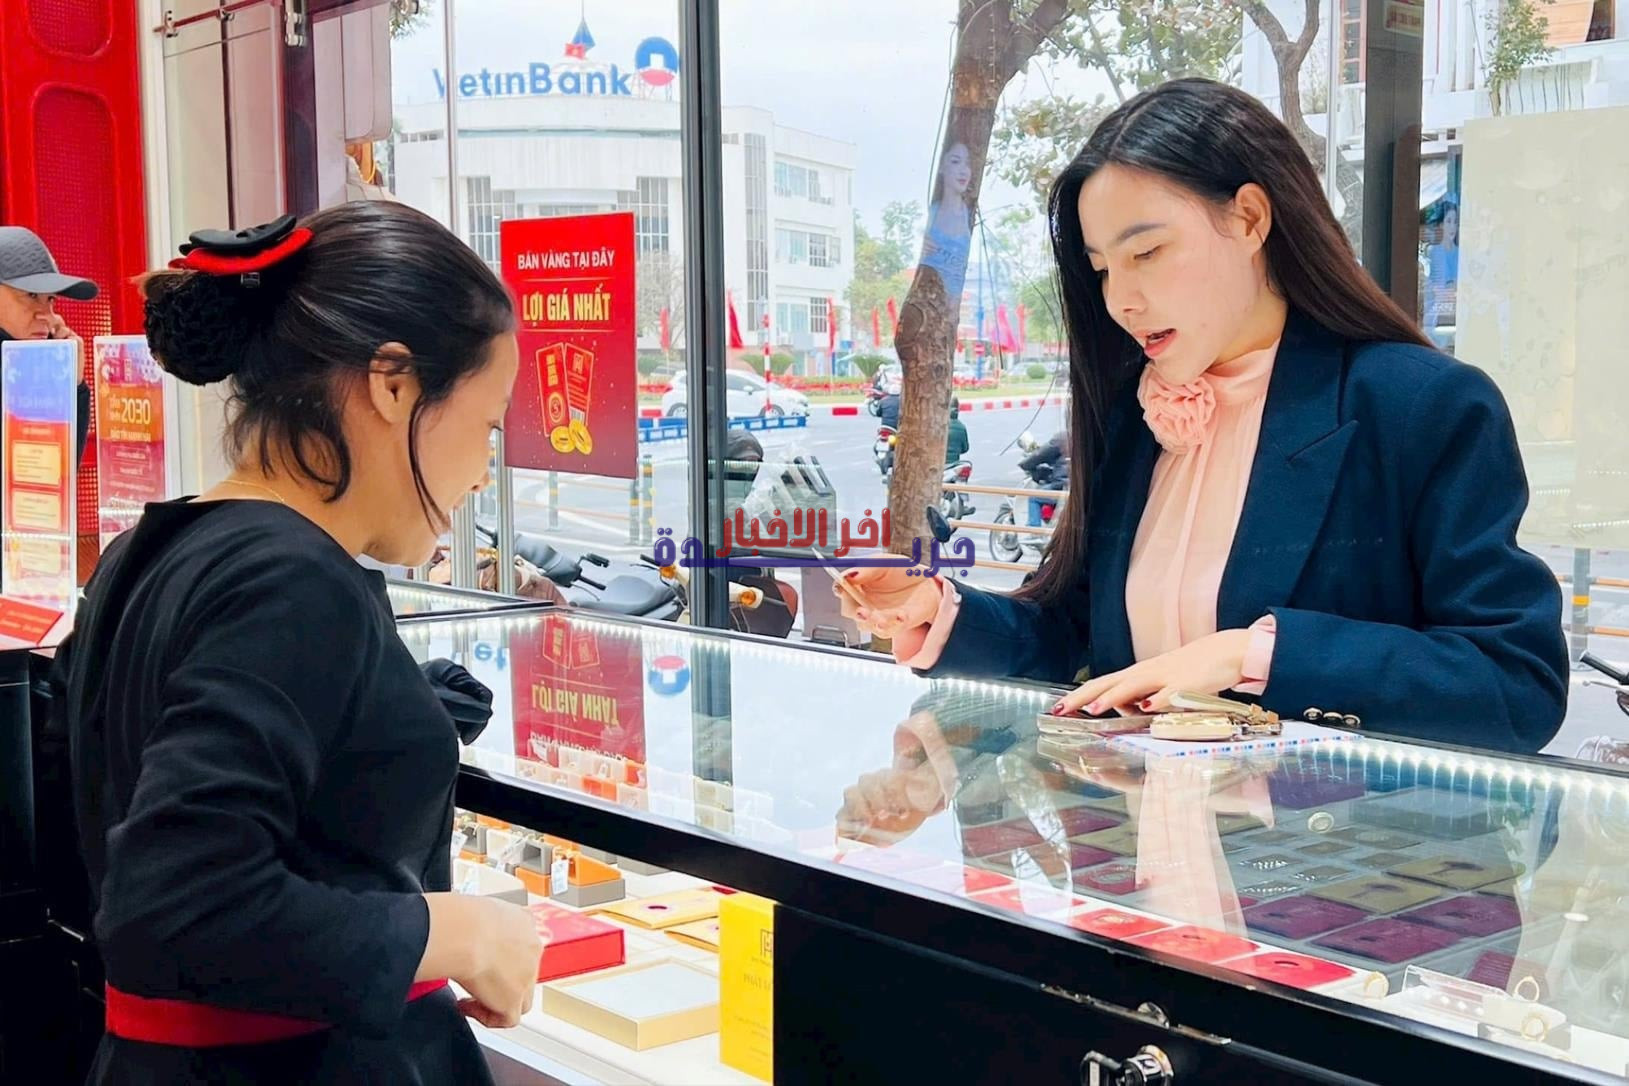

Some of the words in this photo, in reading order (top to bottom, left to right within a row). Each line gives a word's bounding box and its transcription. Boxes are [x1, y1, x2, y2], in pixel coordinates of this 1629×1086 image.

[517, 250, 540, 270] BÁN
[541, 249, 571, 269] VÀNG
[572, 251, 590, 270] TẠI
[591, 246, 615, 268] ĐÂY
[522, 291, 544, 327] LỢI
[546, 288, 571, 321] GIÁ
[573, 283, 611, 321] NHẤT
[121, 397, 151, 425] 2030
